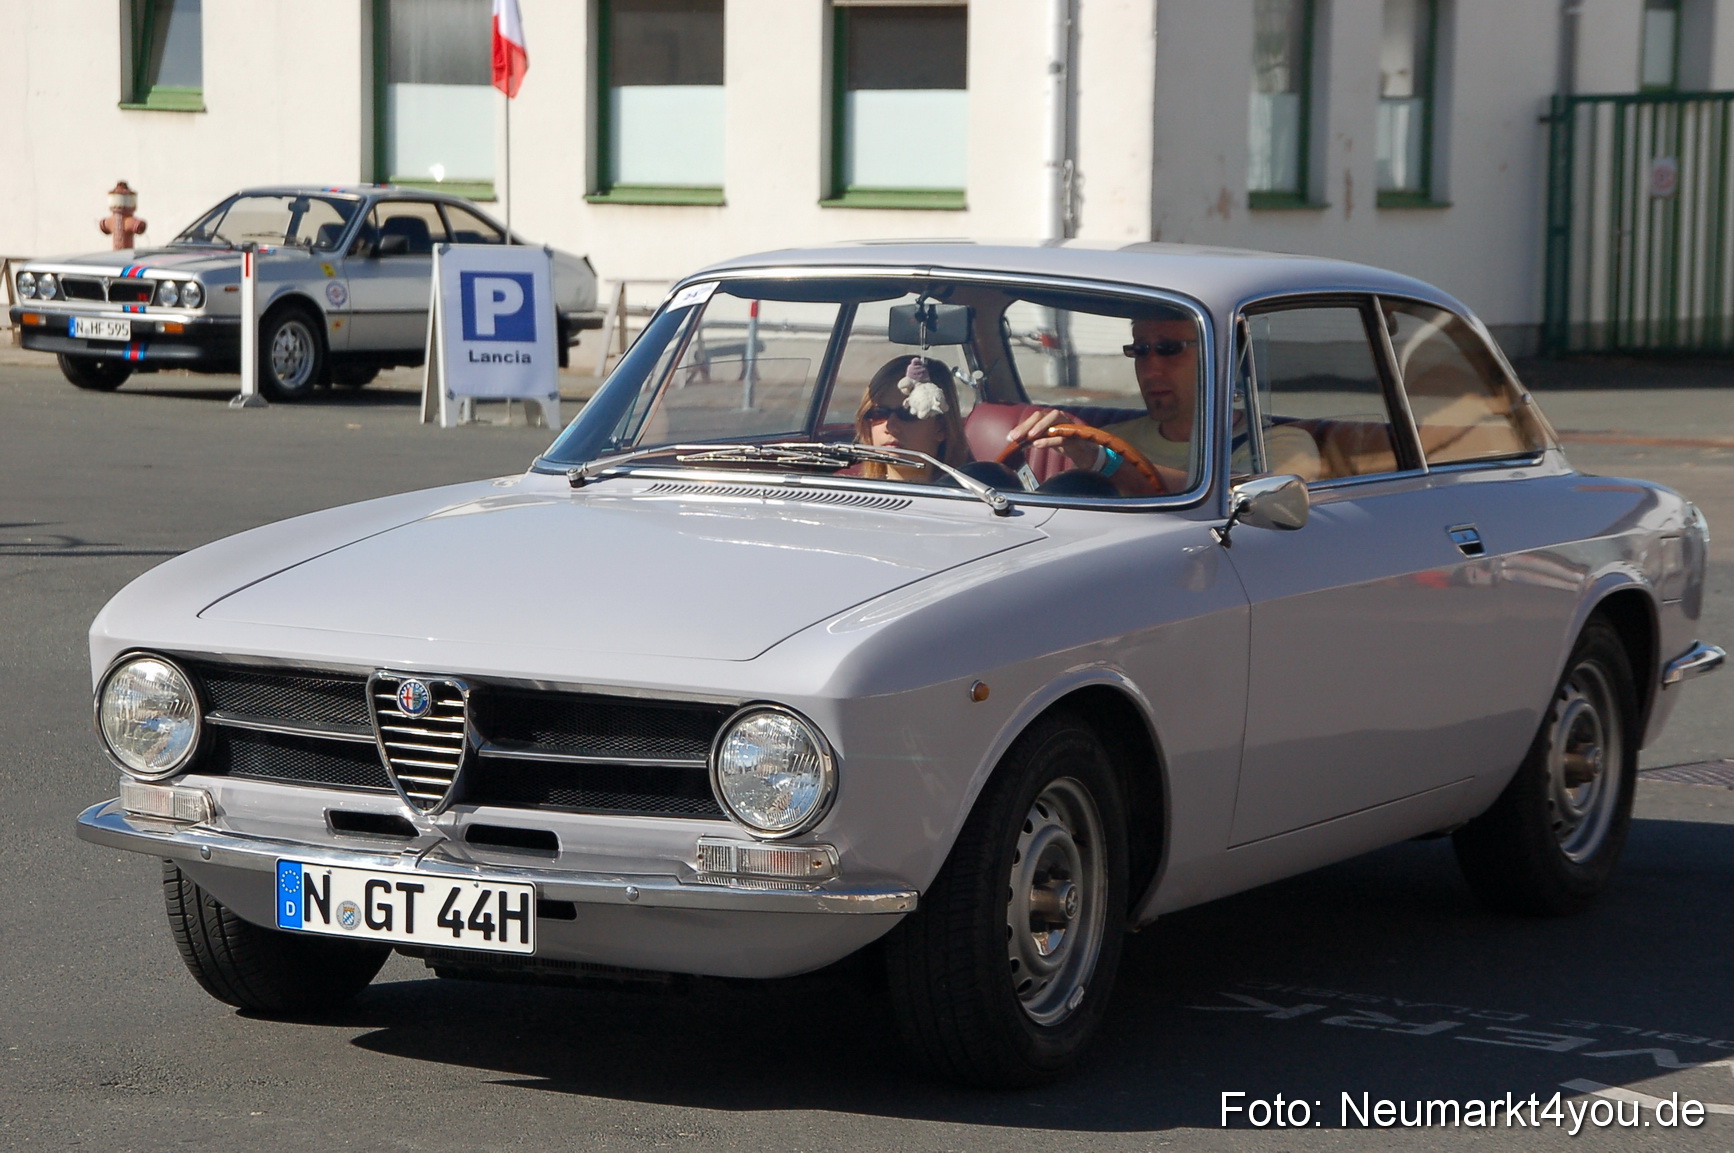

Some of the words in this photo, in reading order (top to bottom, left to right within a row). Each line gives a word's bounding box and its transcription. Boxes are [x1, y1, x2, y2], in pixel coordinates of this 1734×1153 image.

[473, 277, 524, 336] P
[76, 319, 84, 334] N
[91, 321, 105, 335] HF
[107, 322, 129, 336] 595
[469, 350, 532, 364] Lancia
[285, 901, 296, 916] D
[303, 871, 331, 925] N
[364, 879, 424, 934] GT
[437, 887, 529, 944] 44H
